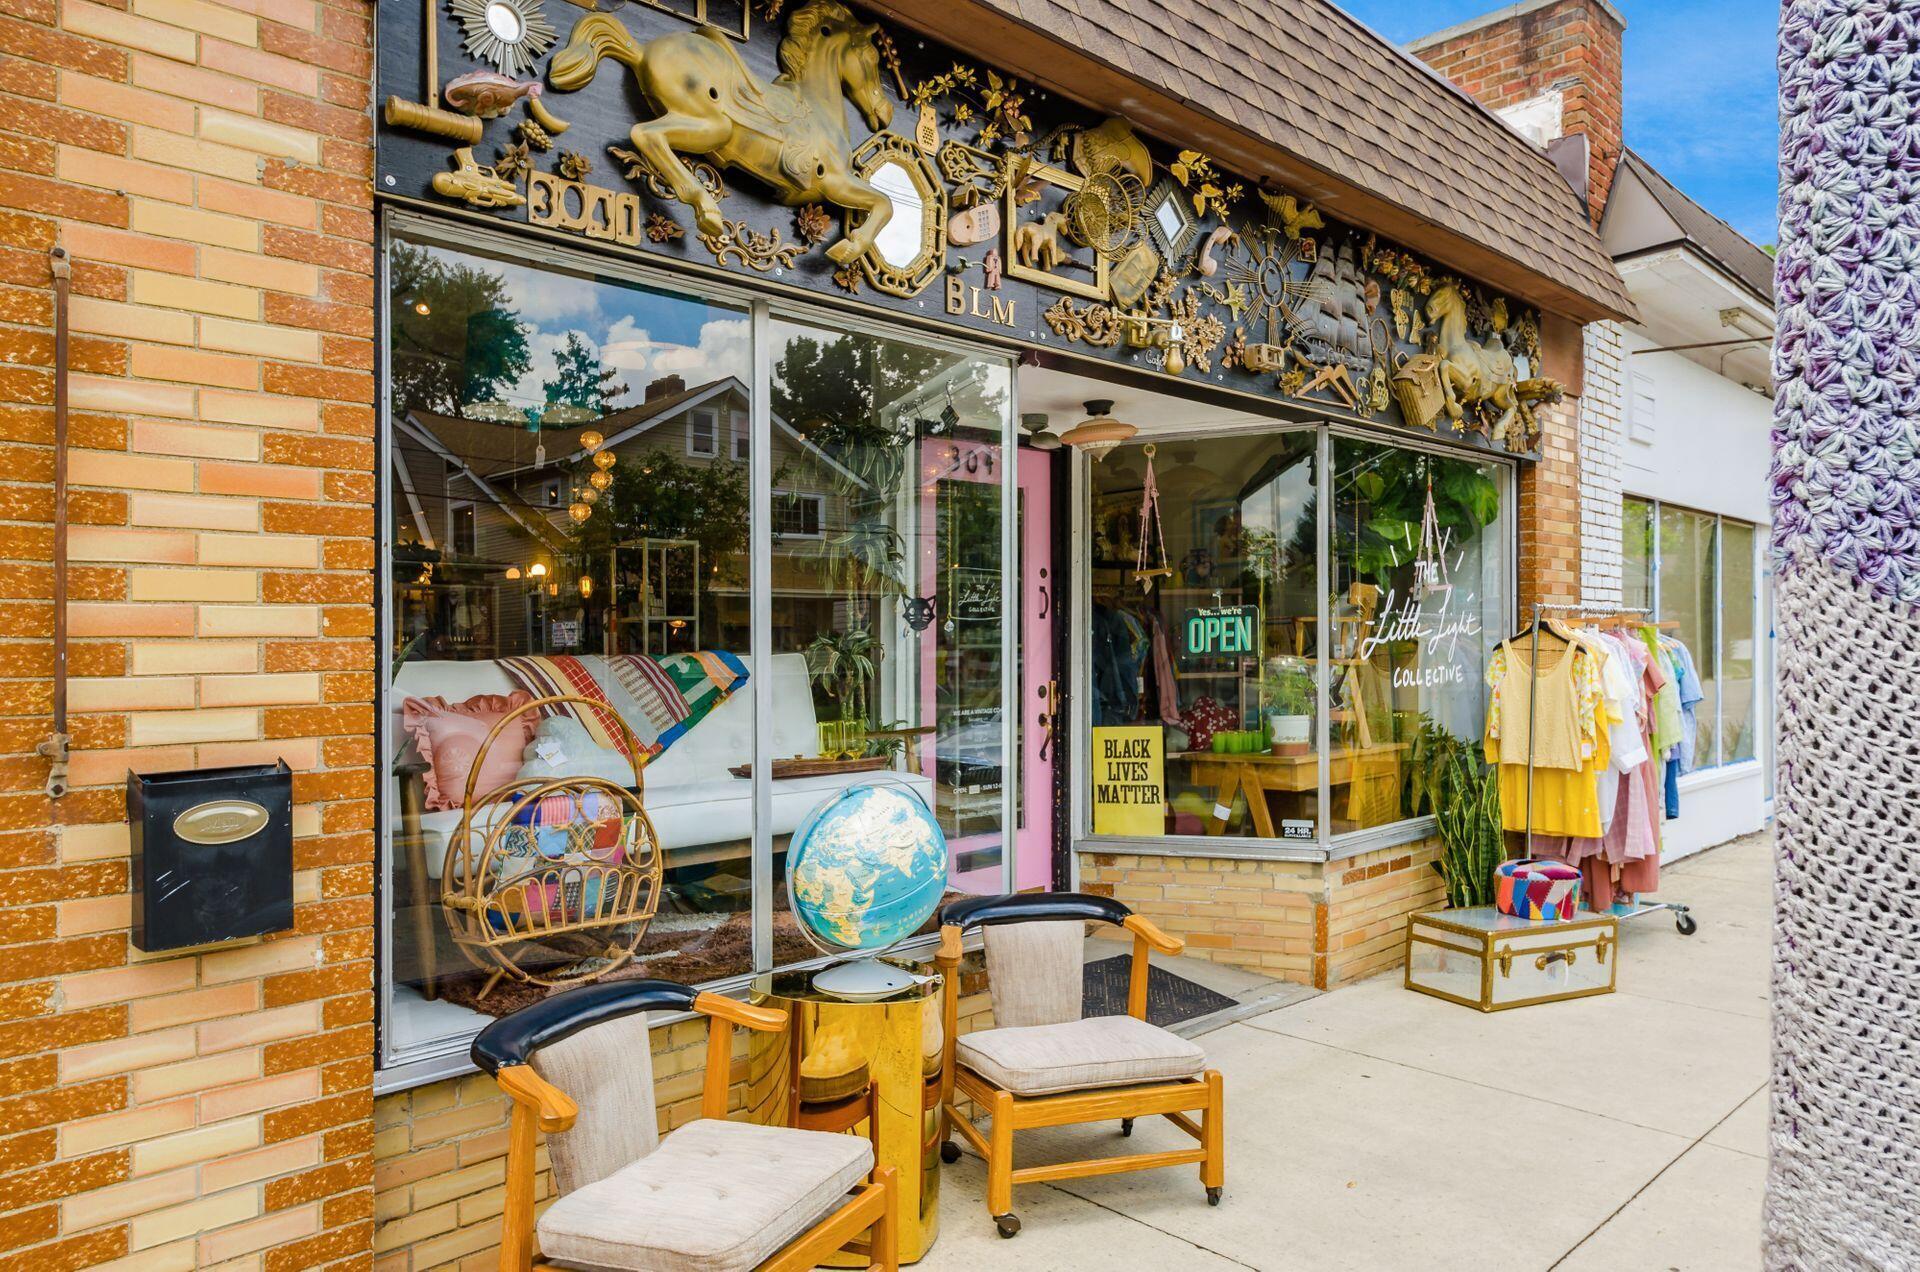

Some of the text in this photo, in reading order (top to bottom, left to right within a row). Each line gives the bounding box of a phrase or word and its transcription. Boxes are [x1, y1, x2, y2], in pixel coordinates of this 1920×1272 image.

[947, 275, 1016, 328] BLM
[1415, 561, 1439, 584] THE
[1188, 615, 1252, 653] OPEN
[1361, 586, 1481, 662] Little Light
[1393, 664, 1464, 689] COLLECTIVE
[1103, 738, 1152, 759] BLACK
[1107, 761, 1149, 781] LIVES
[1097, 784, 1161, 805] MATTER
